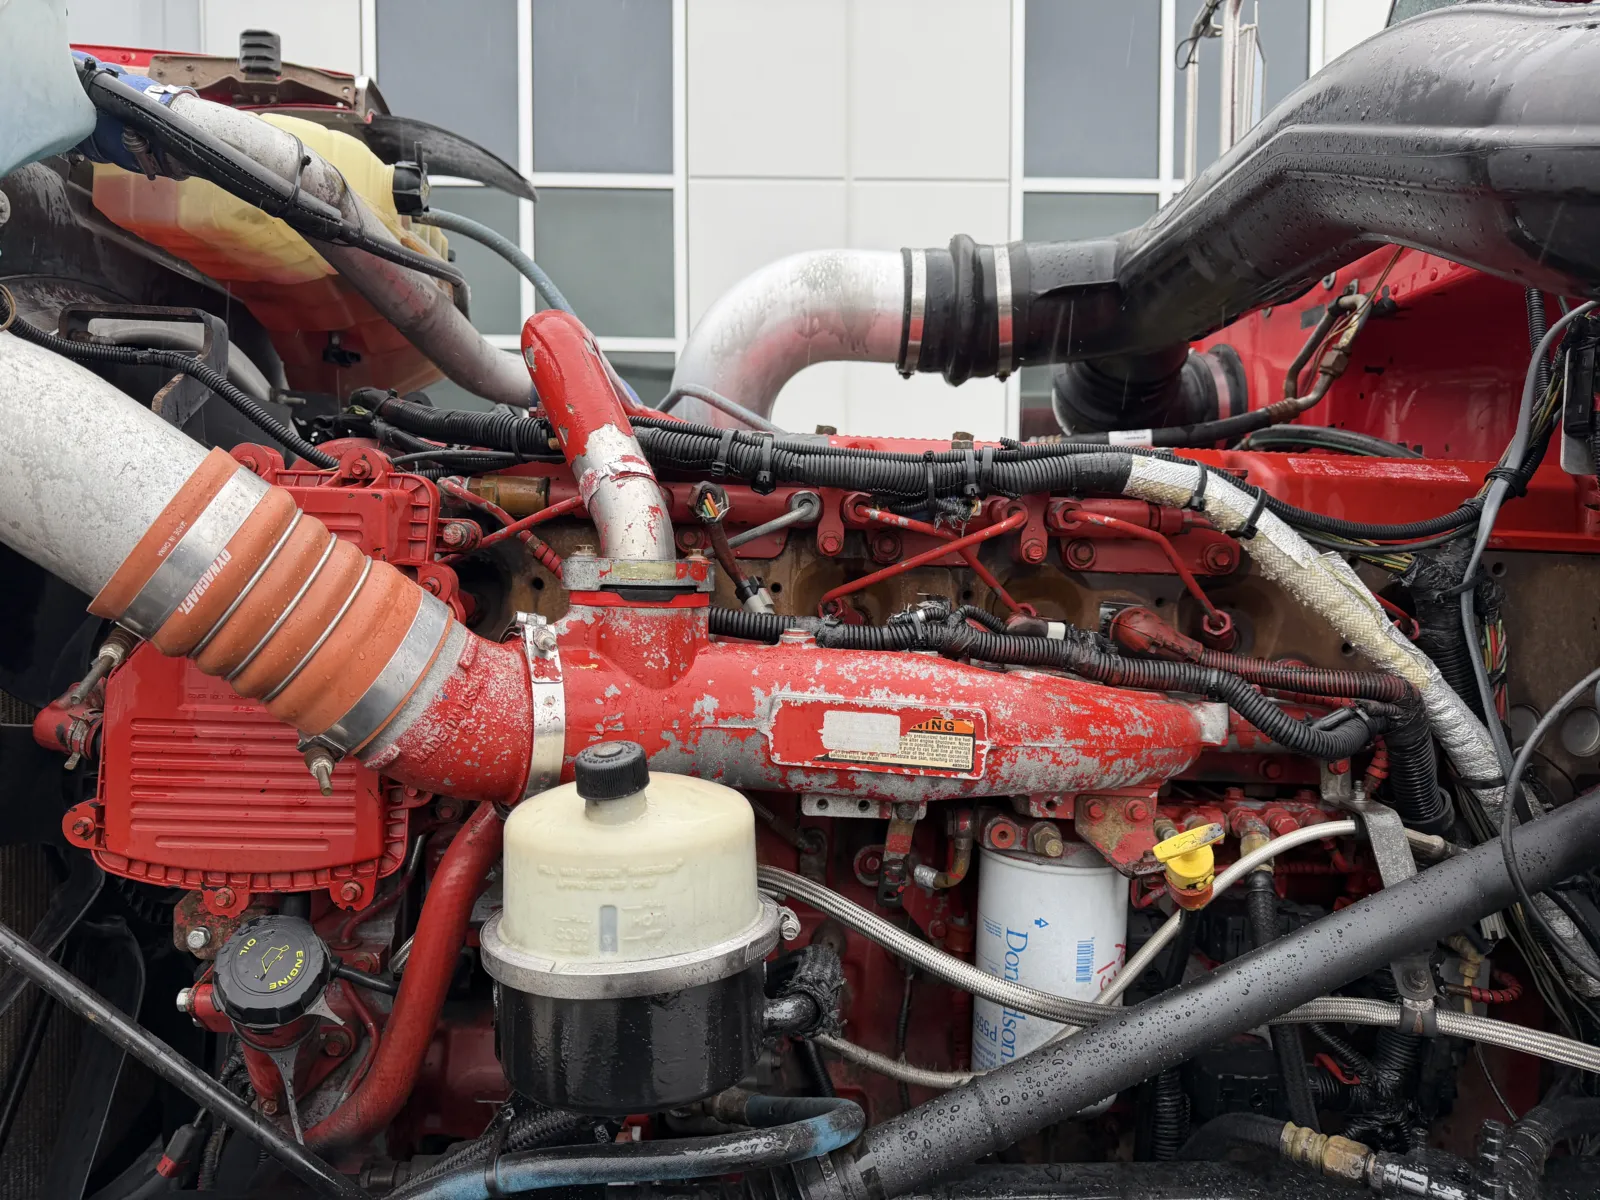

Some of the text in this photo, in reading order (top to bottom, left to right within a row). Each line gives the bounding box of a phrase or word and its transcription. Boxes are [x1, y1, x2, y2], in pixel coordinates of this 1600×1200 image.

[156, 542, 171, 556] CHINA
[632, 912, 662, 927] HOT
[556, 927, 590, 941] COLD
[239, 938, 257, 956] OIL
[269, 950, 304, 990] ENGINE
[1001, 927, 1028, 1058] Donson
